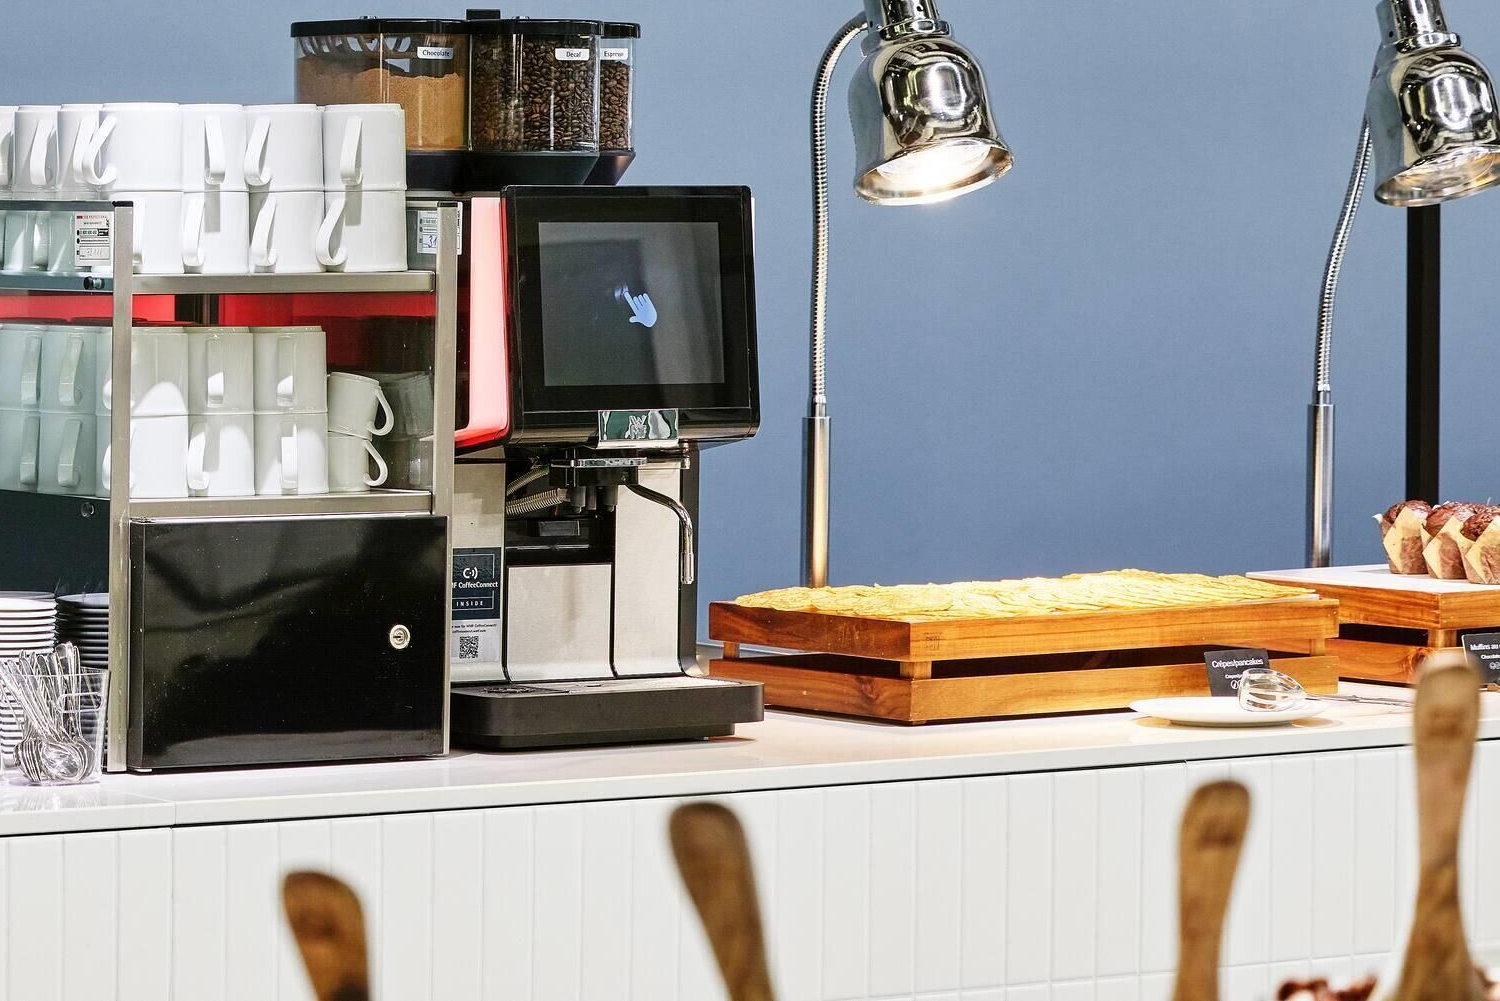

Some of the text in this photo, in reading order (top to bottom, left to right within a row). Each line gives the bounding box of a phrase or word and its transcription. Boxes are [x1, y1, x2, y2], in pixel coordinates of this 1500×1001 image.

[422, 49, 450, 57] Chocolate
[603, 51, 624, 59] Espresso
[458, 581, 499, 589] CoffeeConnect
